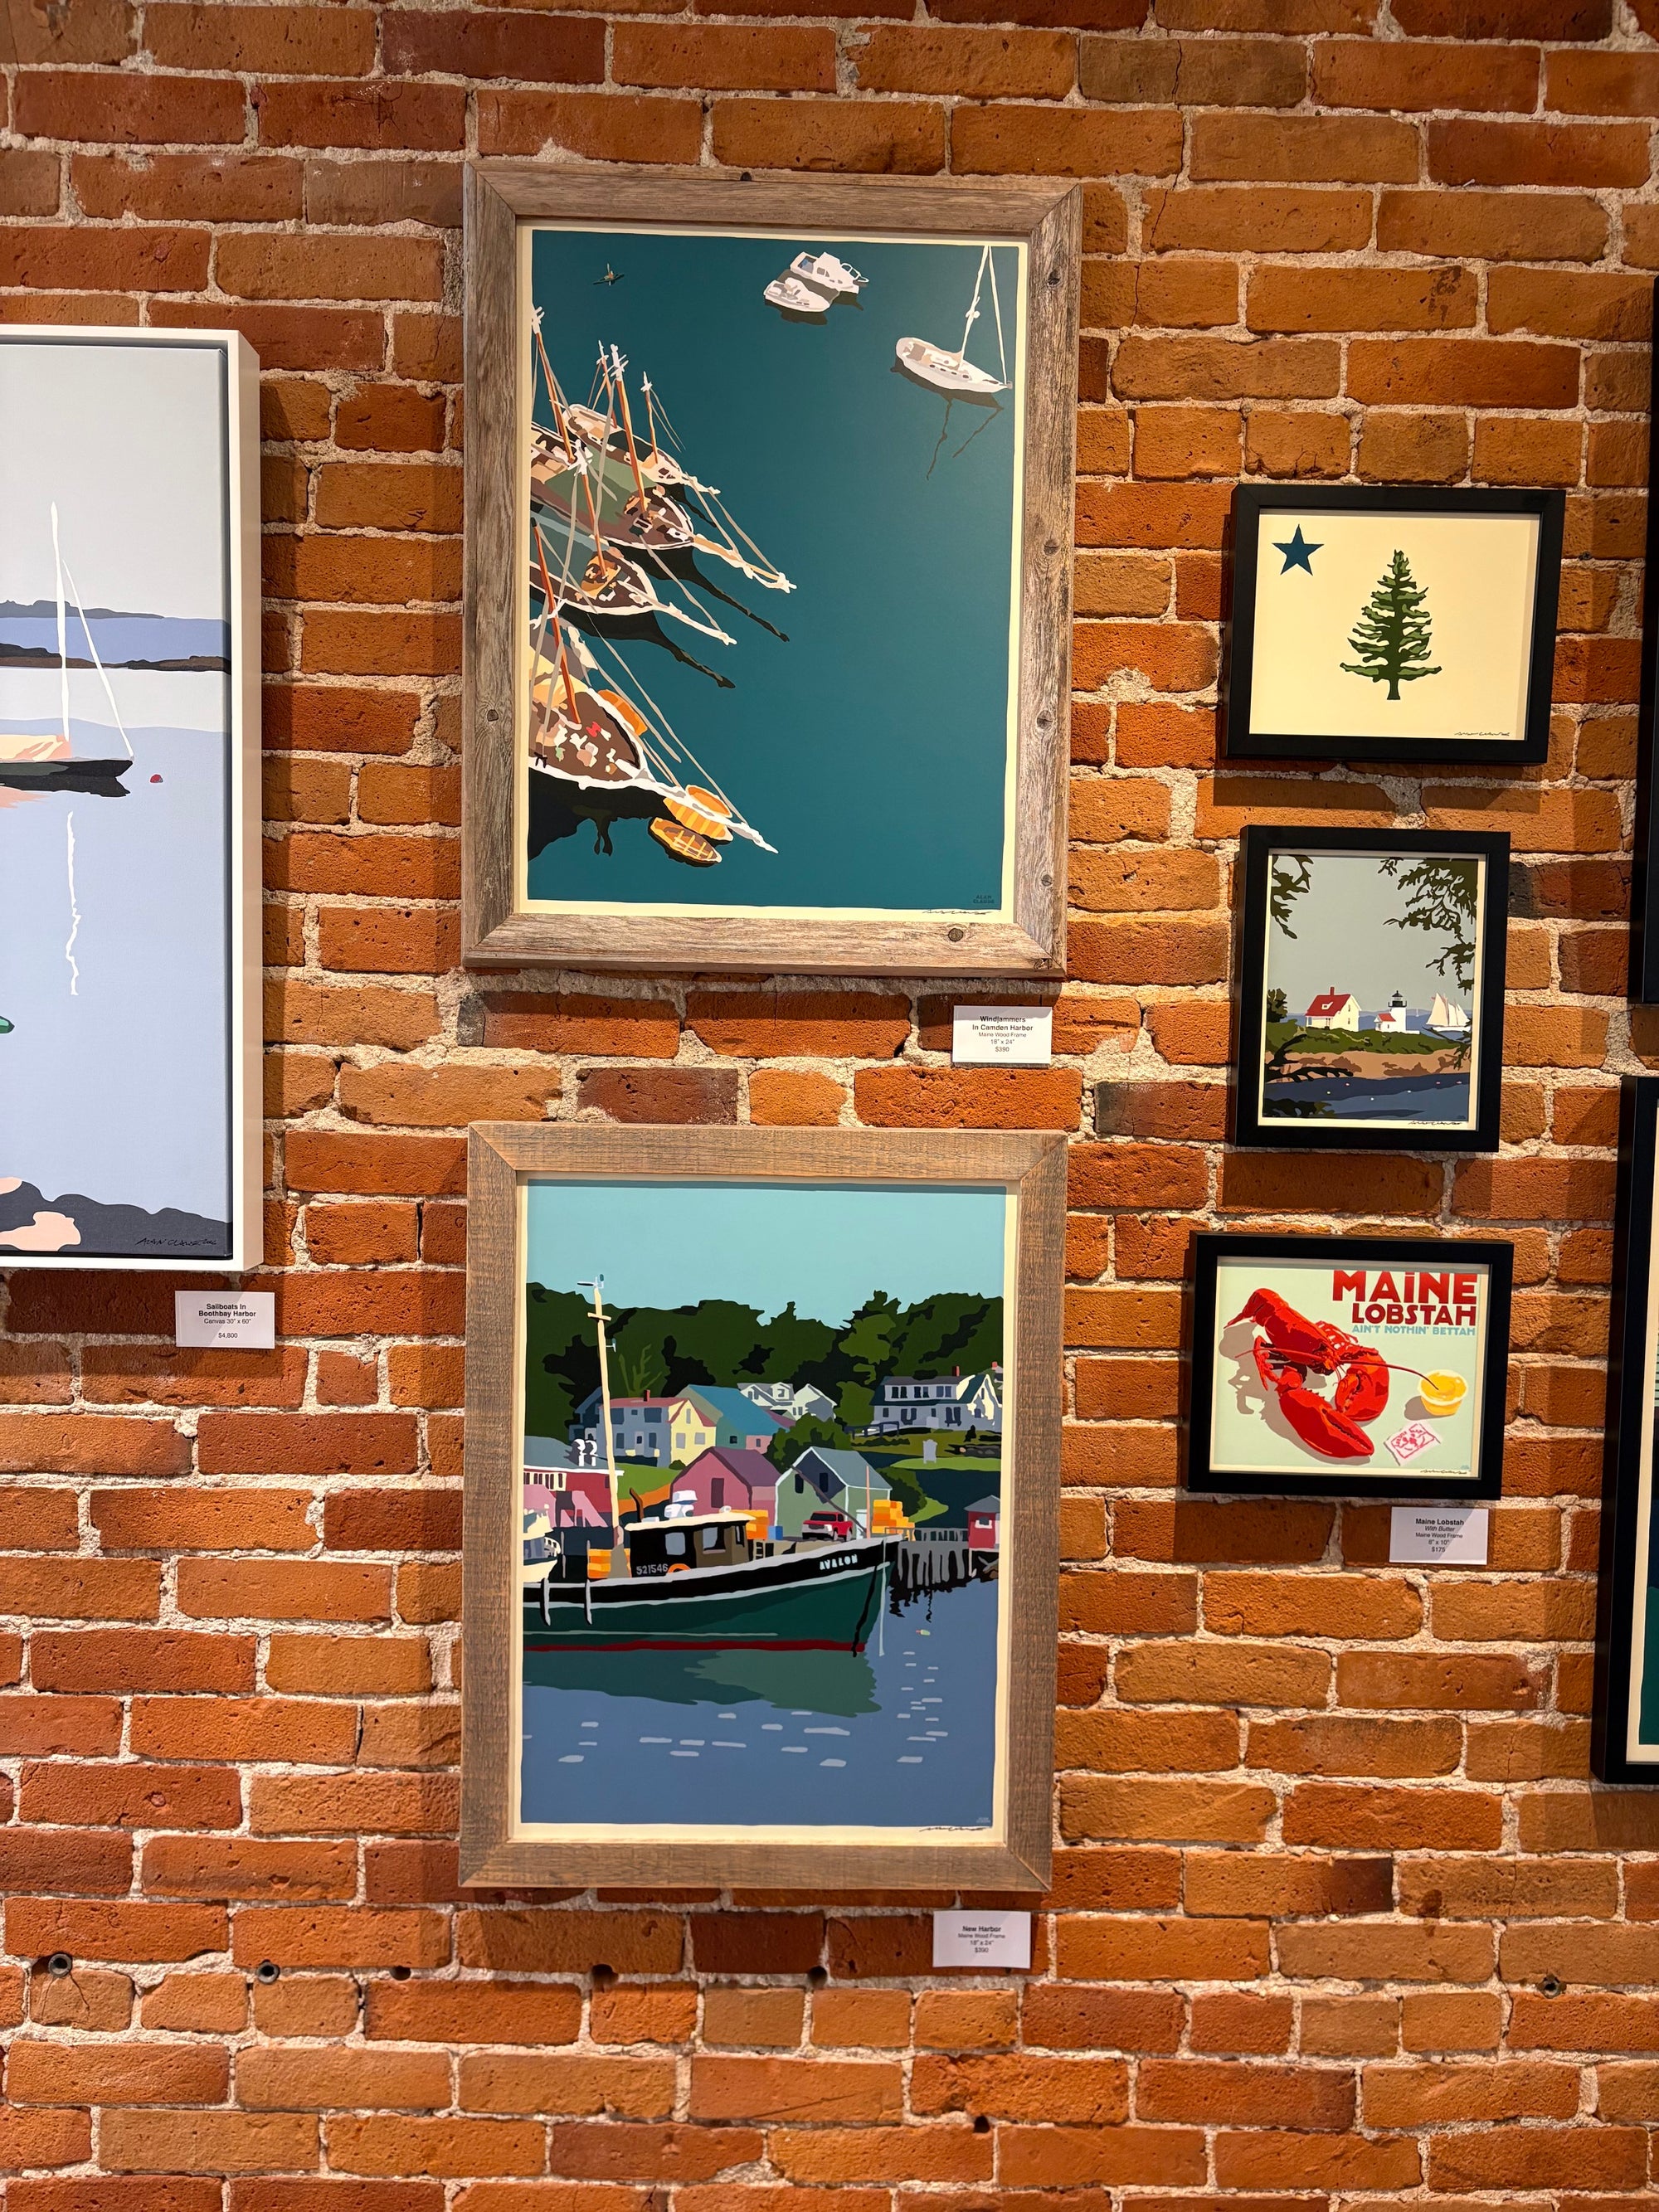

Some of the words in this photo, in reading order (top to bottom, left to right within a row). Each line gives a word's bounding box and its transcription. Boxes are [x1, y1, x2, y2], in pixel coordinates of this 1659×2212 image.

[1352, 1303, 1476, 1326] LOBSTAH
[1352, 1325, 1380, 1333] AIN'T
[1384, 1325, 1429, 1334] NOTHIN'
[1433, 1327, 1475, 1335] BETTAH
[636, 1563, 668, 1575] 521546
[820, 1554, 858, 1570] AVALON
